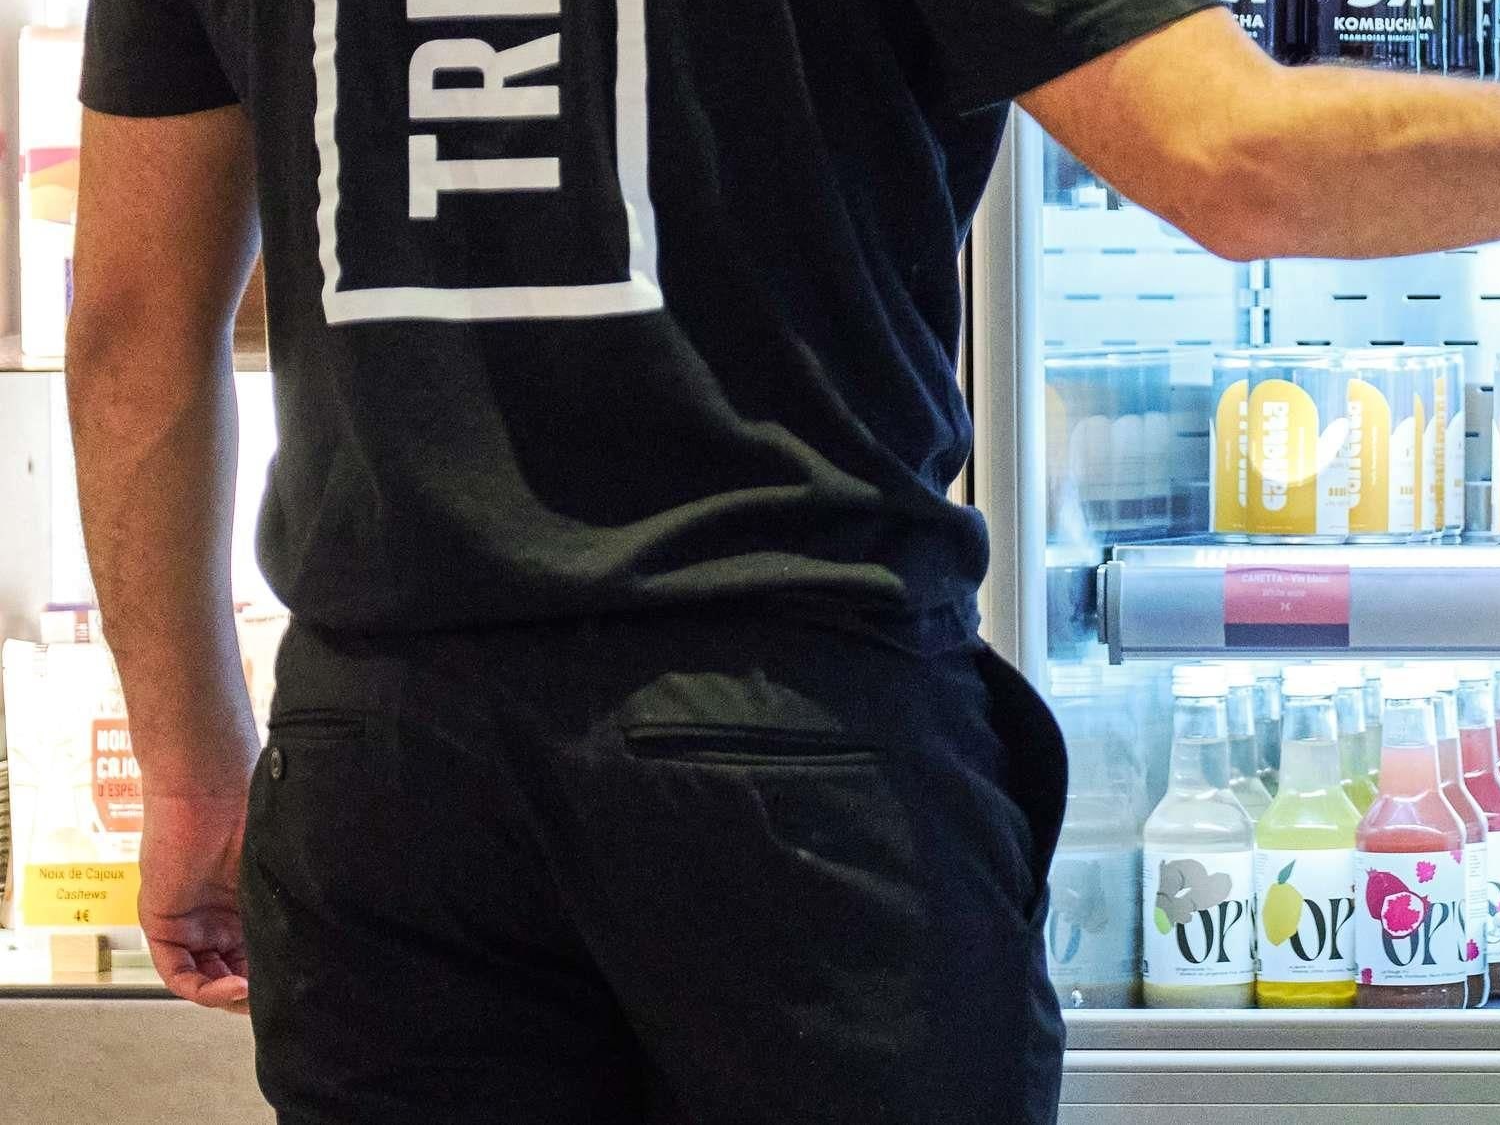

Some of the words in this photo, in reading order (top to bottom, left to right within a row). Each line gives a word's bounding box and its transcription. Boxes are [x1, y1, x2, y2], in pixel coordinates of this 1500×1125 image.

[39, 868, 65, 880] Noix
[68, 867, 82, 879] de
[86, 868, 125, 882] Cajoux
[56, 888, 107, 900] Cashews
[74, 910, 90, 923] 4€
